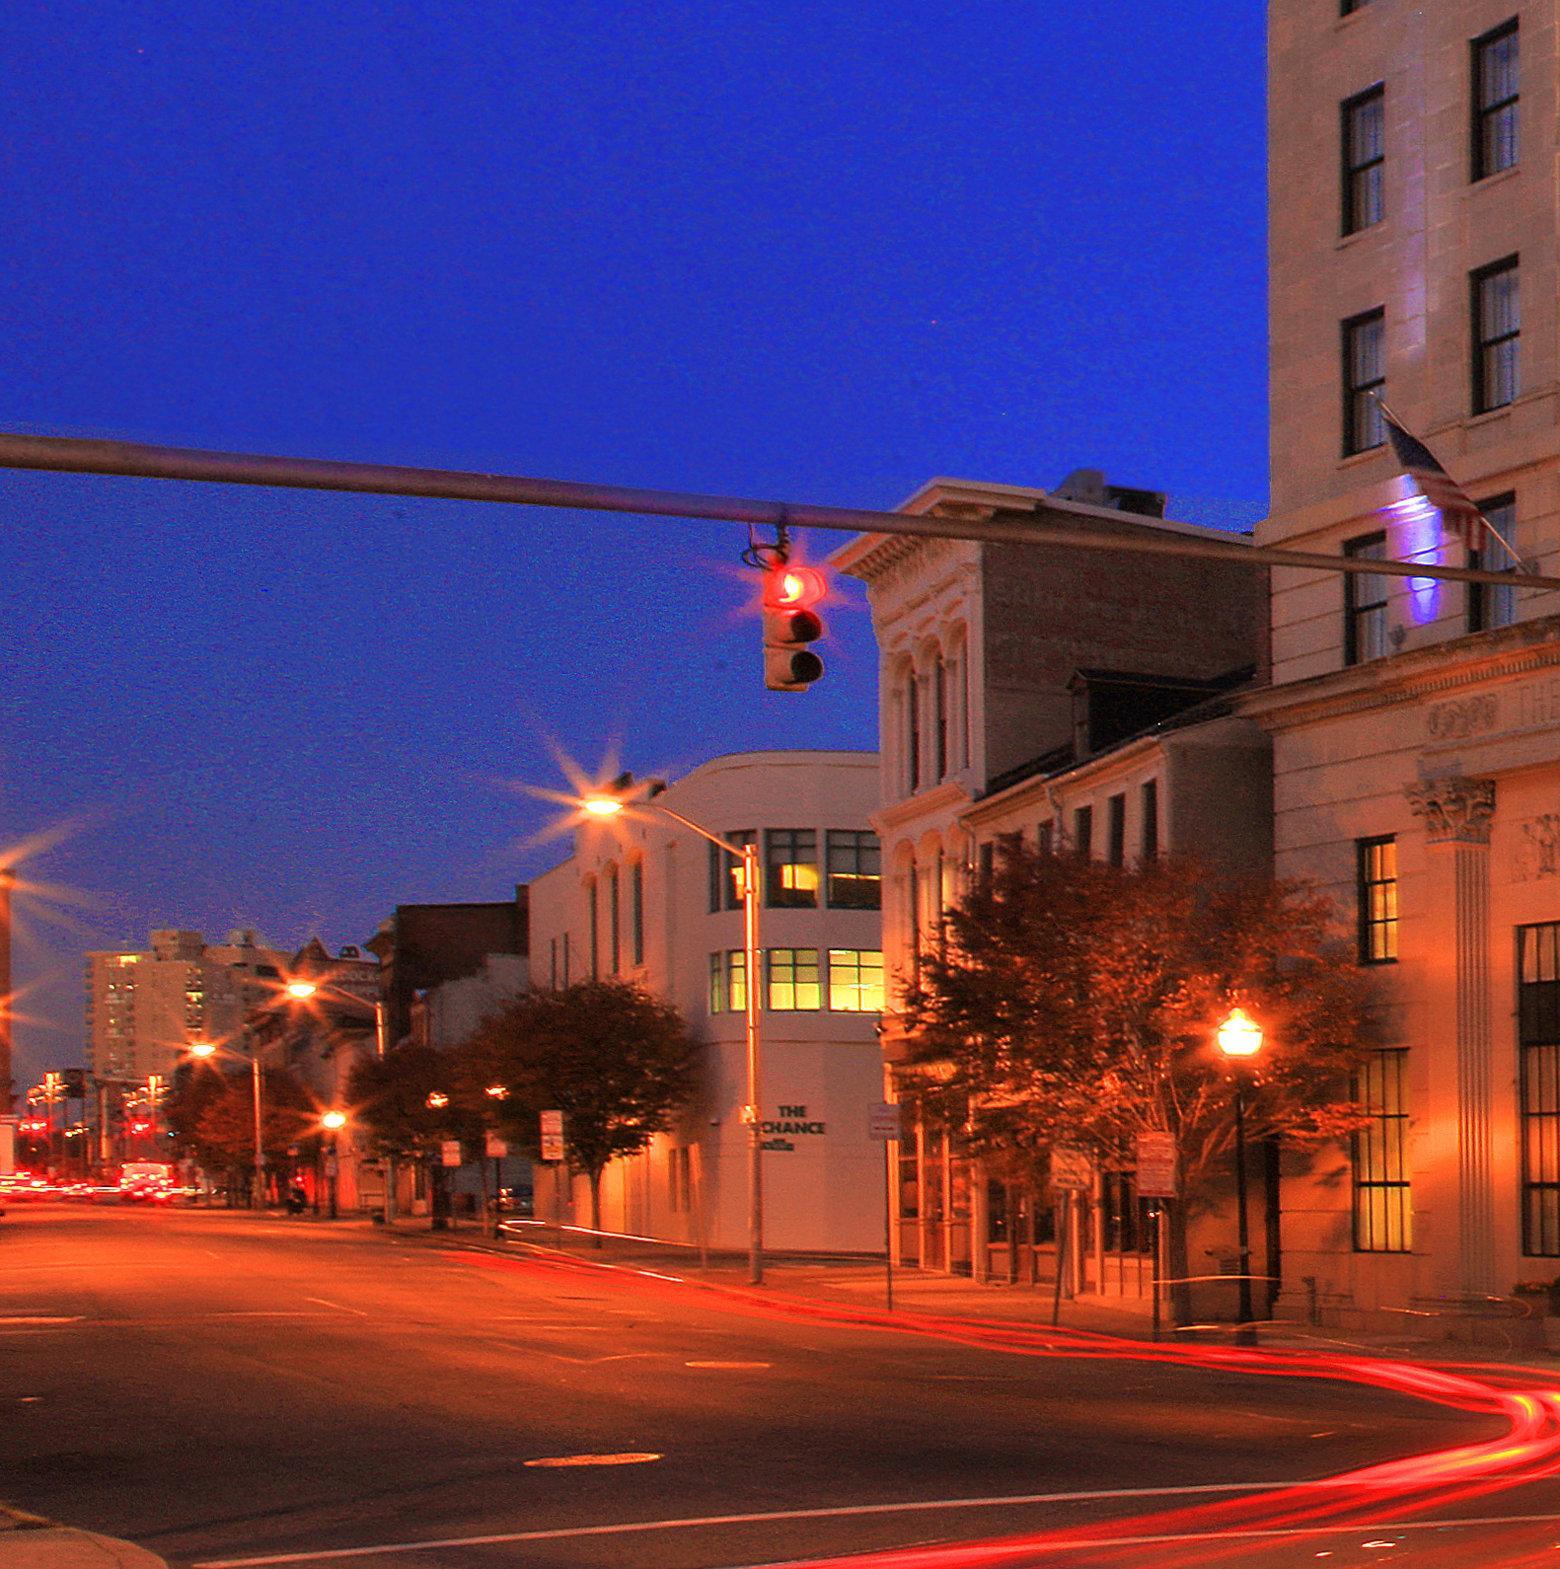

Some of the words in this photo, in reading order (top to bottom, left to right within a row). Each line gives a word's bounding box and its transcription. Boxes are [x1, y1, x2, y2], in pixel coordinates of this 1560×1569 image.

[1518, 678, 1558, 724] THE
[778, 1106, 806, 1117] THE
[762, 1121, 826, 1134] CHANCE
